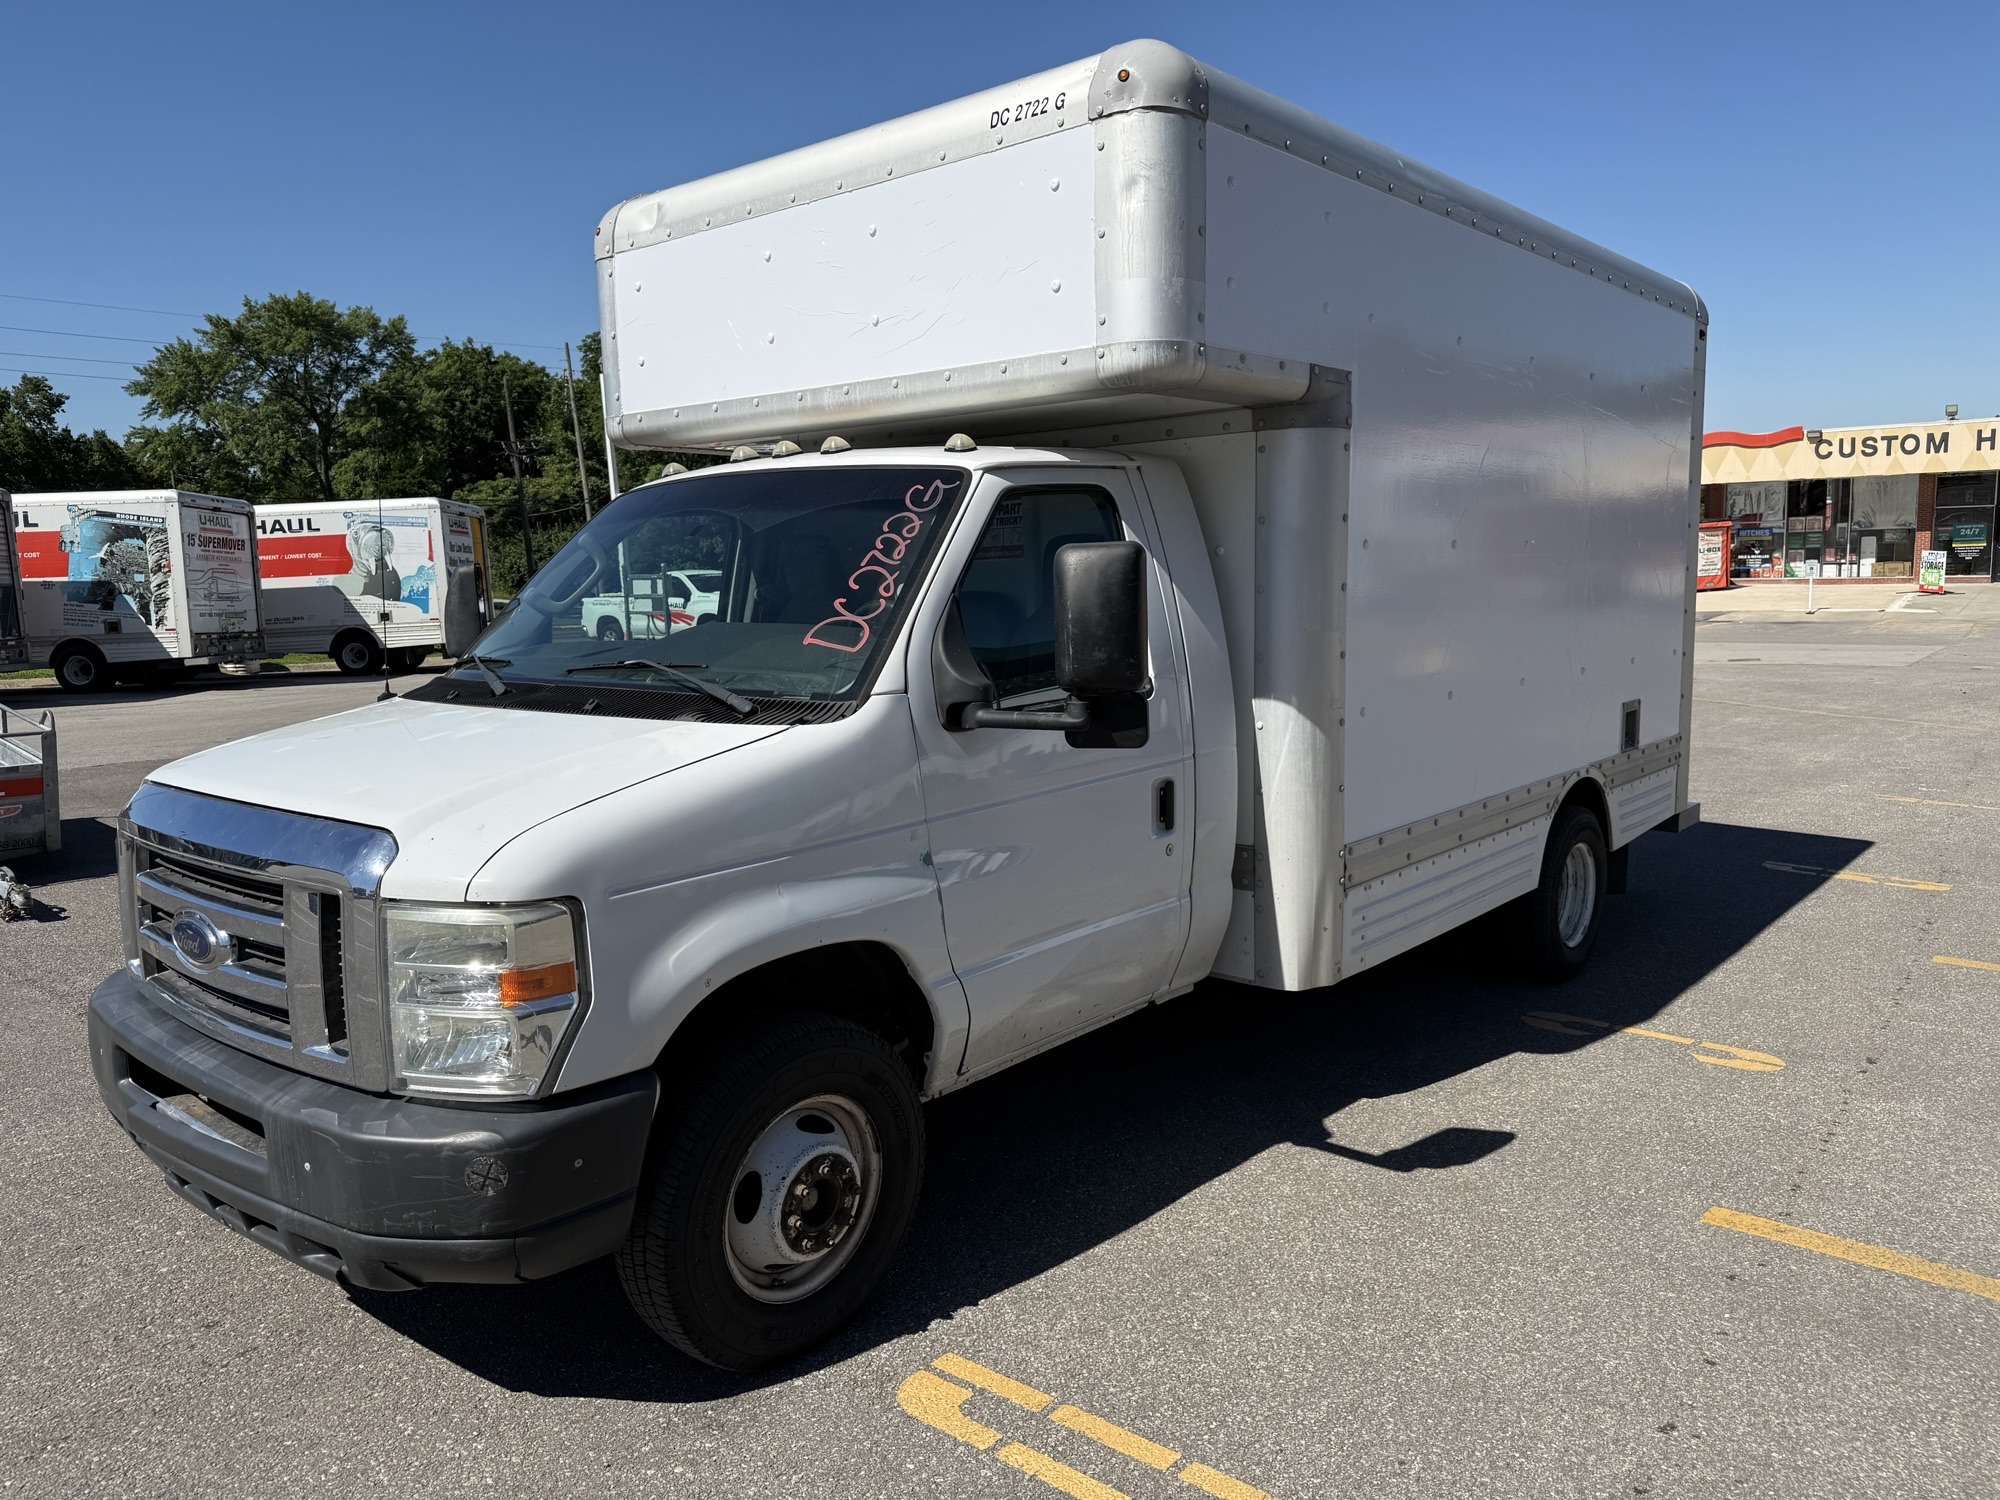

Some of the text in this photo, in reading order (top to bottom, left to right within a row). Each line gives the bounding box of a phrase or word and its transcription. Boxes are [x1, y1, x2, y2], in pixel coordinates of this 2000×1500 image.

[989, 92, 1066, 130] DC 2722 G
[1814, 428, 1996, 460] CUSTOM H
[998, 502, 1022, 516] PART
[116, 513, 138, 521] RHODE
[199, 513, 232, 528] U-HAUL
[995, 515, 1023, 527] TRUCK?
[197, 534, 246, 552] SUPERMOVER
[1921, 561, 1944, 570] STORAGE
[12, 837, 34, 847] 2000
[177, 929, 200, 954] Ford
